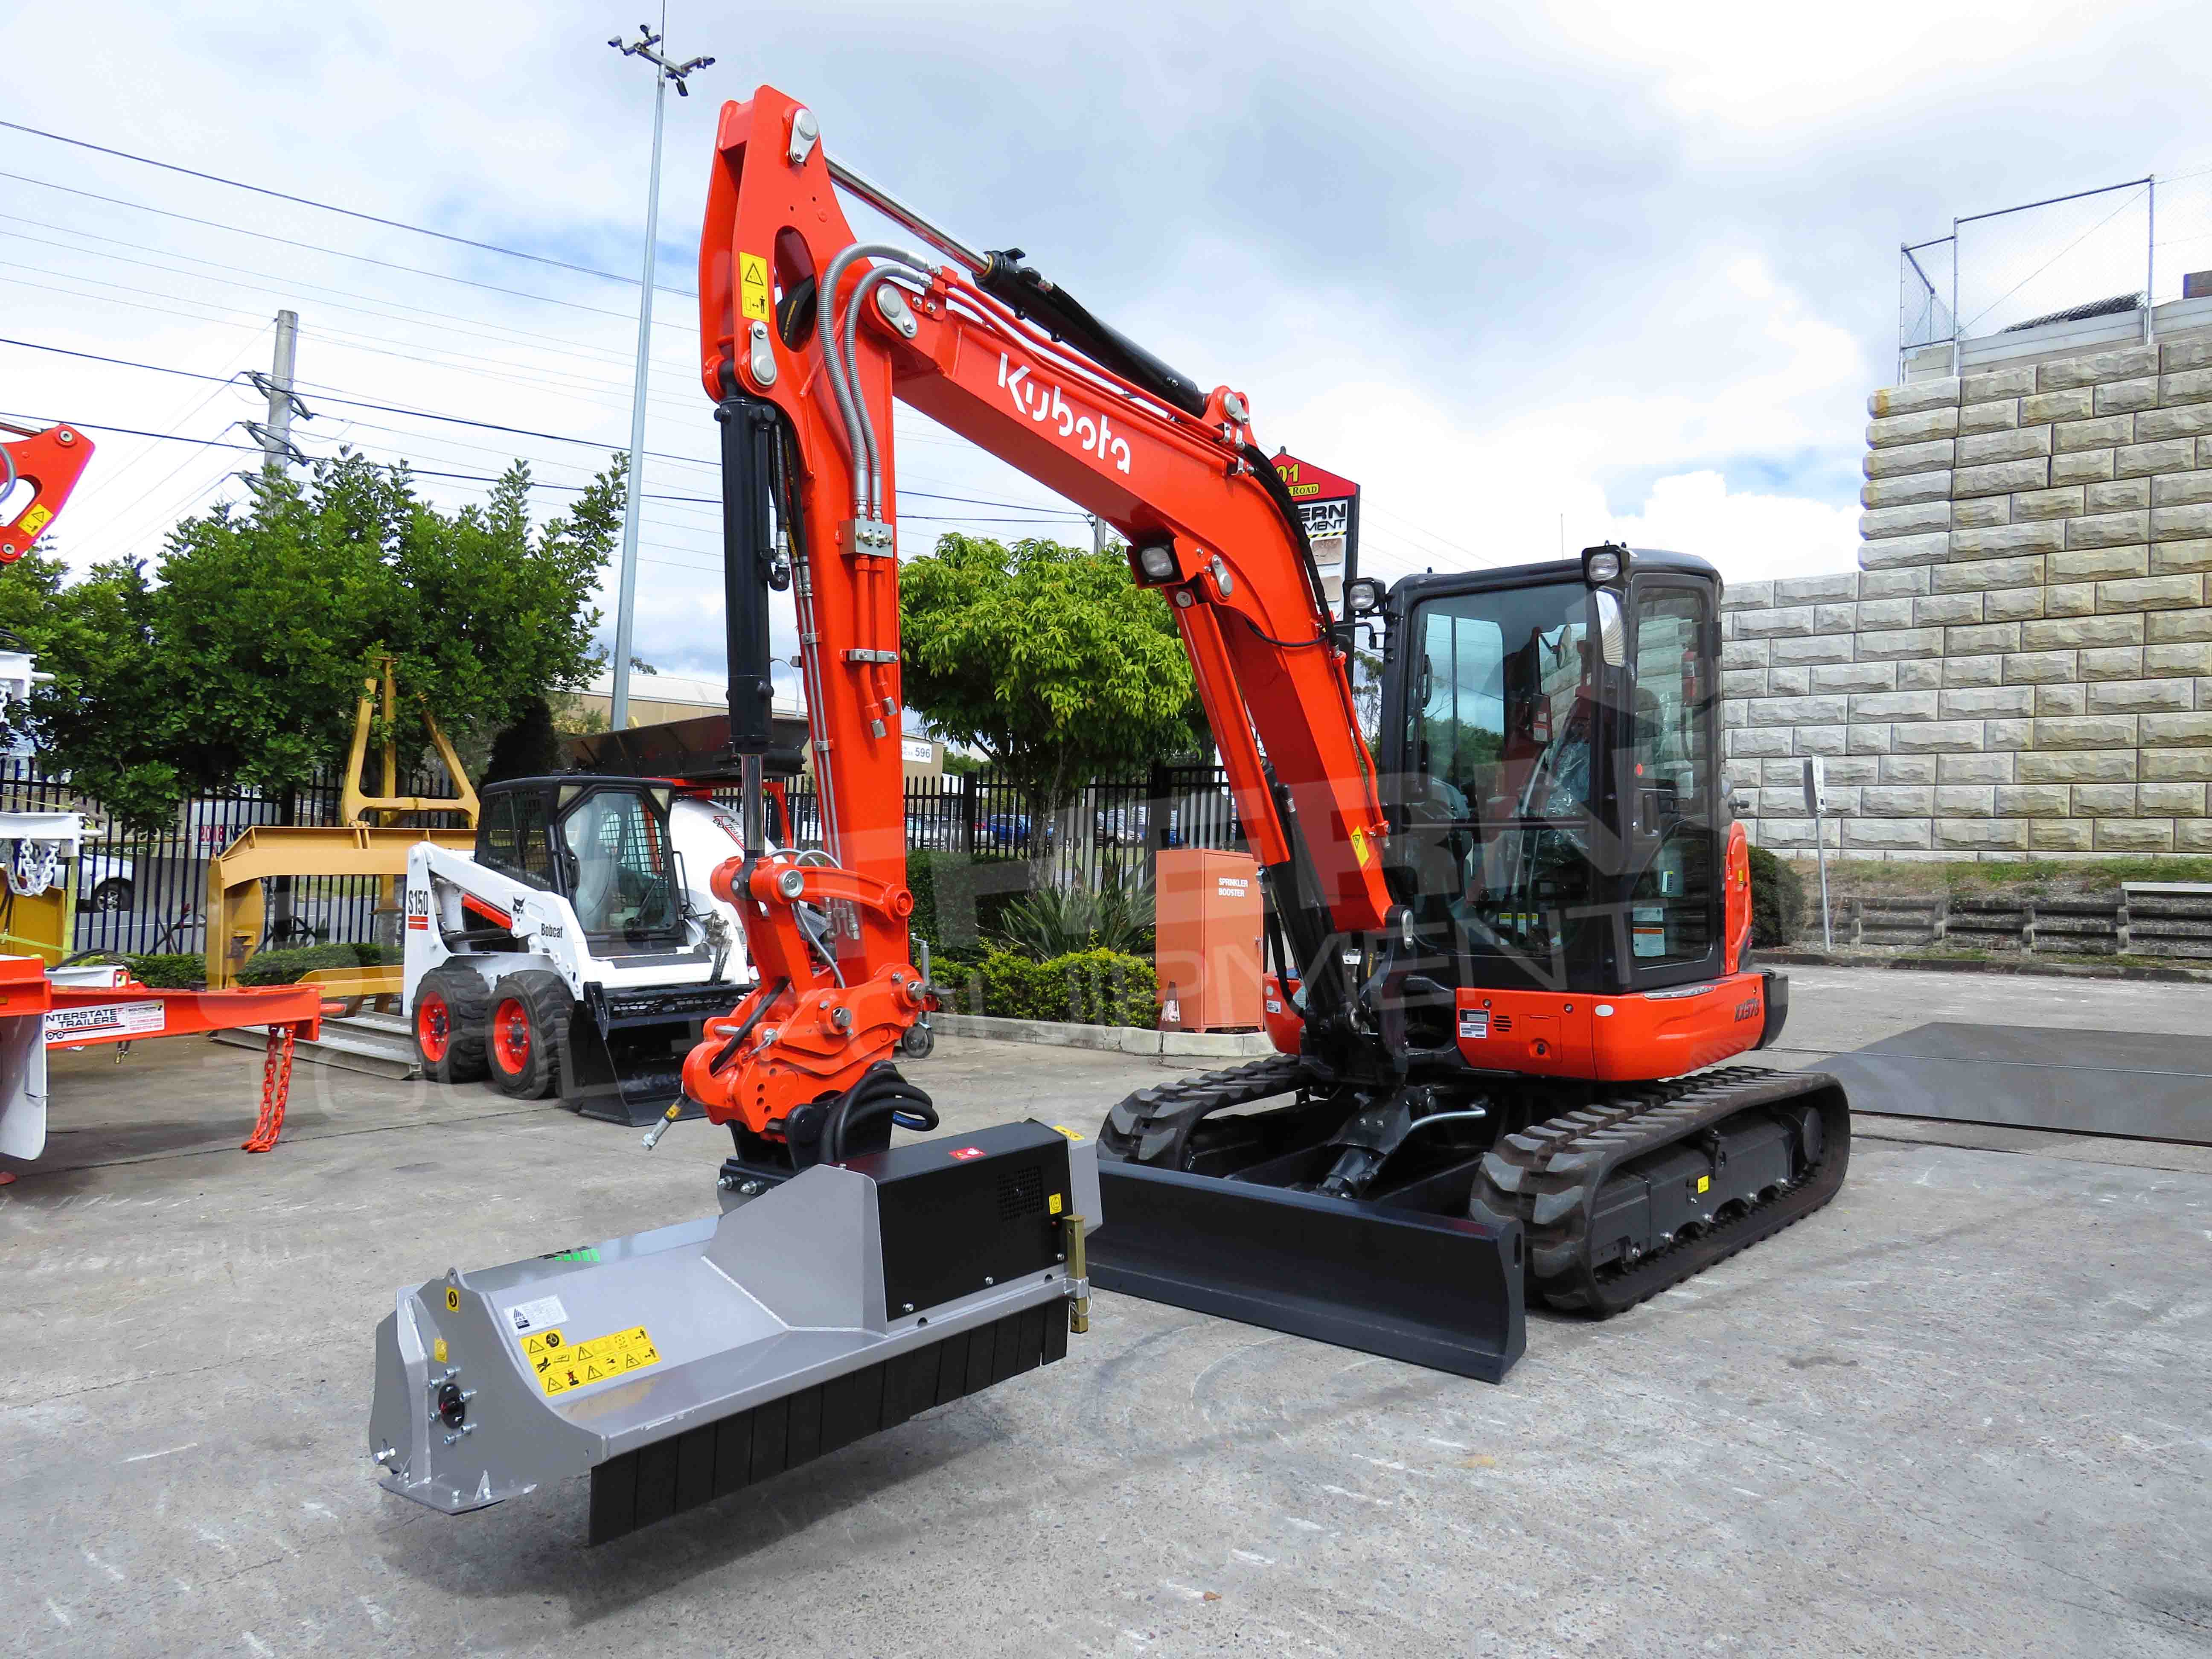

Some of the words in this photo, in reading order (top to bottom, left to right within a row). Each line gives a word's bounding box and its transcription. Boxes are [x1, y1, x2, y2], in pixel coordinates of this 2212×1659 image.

[997, 352, 1131, 475] Kubota
[915, 747, 931, 758] 596
[1218, 877, 1249, 888] SPRINKLER
[1218, 887, 1245, 897] BOOSTER
[408, 890, 428, 916] S150
[541, 923, 563, 939] Bobcat
[45, 1008, 117, 1022] NTERSTATE
[58, 1015, 118, 1028] TRAILERS
